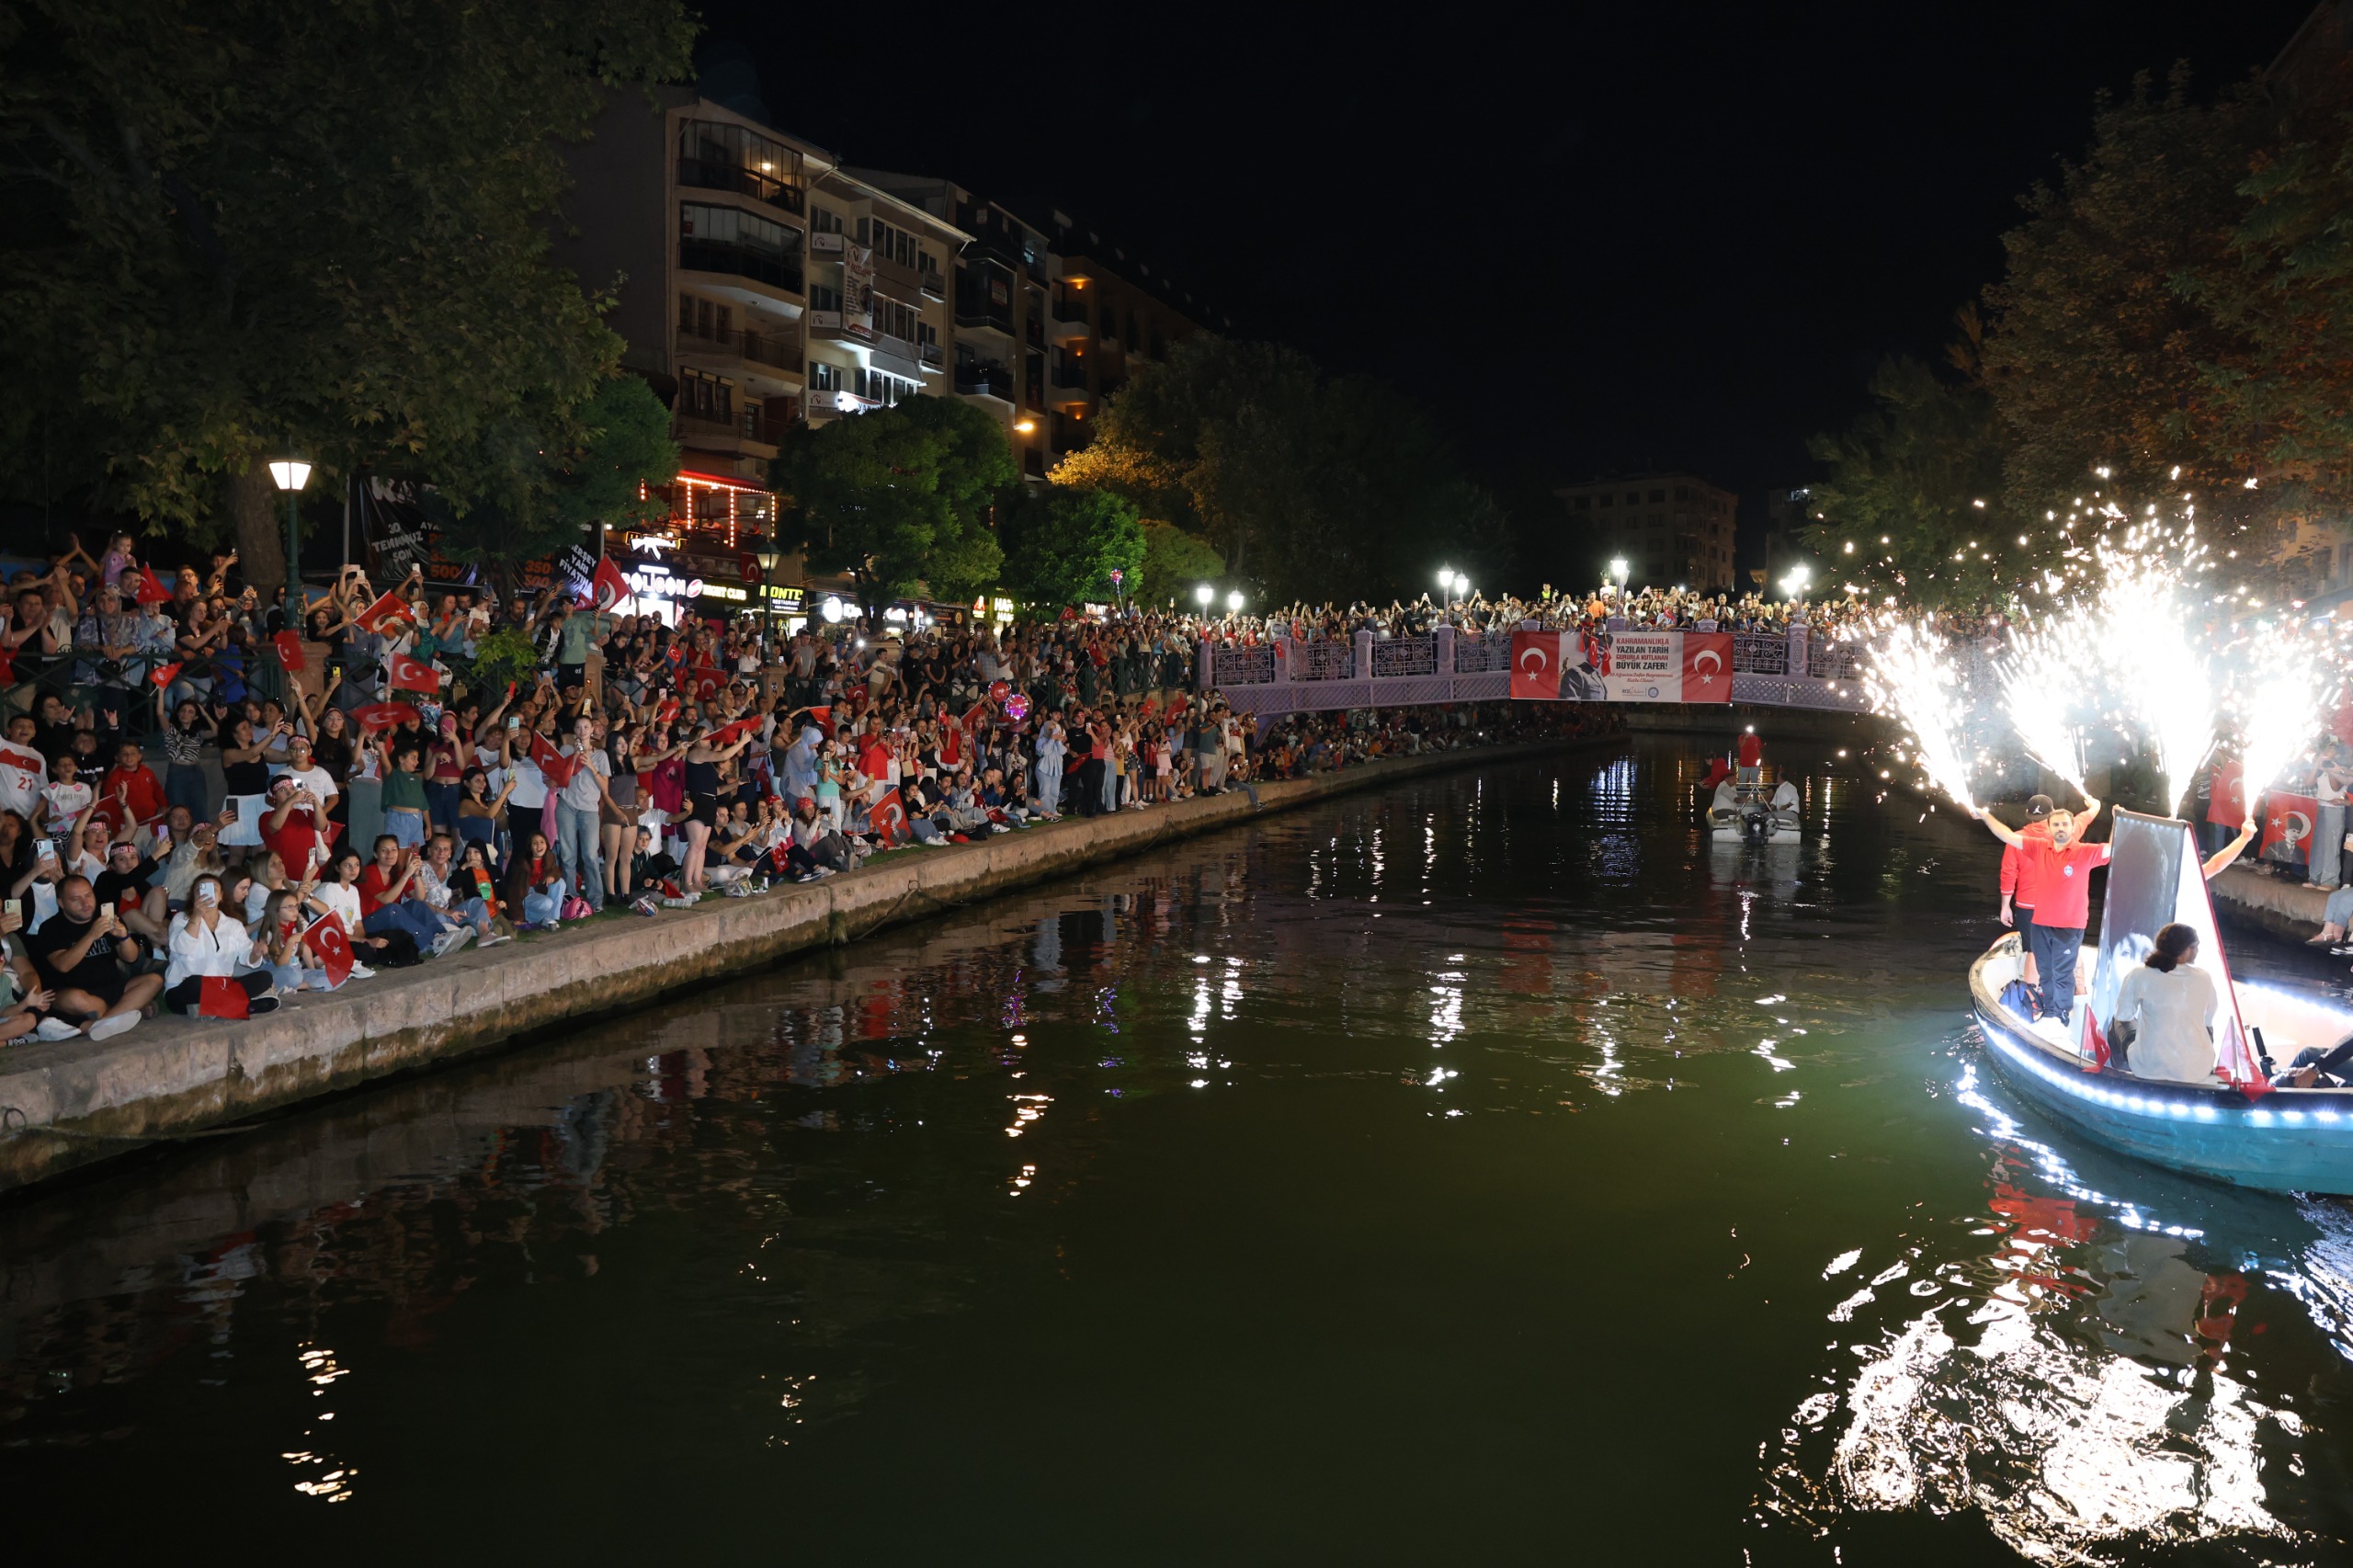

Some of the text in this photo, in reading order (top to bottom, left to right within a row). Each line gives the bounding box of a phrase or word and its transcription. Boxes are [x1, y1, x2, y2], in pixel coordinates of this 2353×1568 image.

[371, 530, 424, 551] TEMMUZ
[392, 549, 414, 562] SON
[726, 588, 747, 600] CLUB
[1648, 644, 1669, 653] TARİH
[1616, 660, 1668, 670] BÜYÜK ZAFER!
